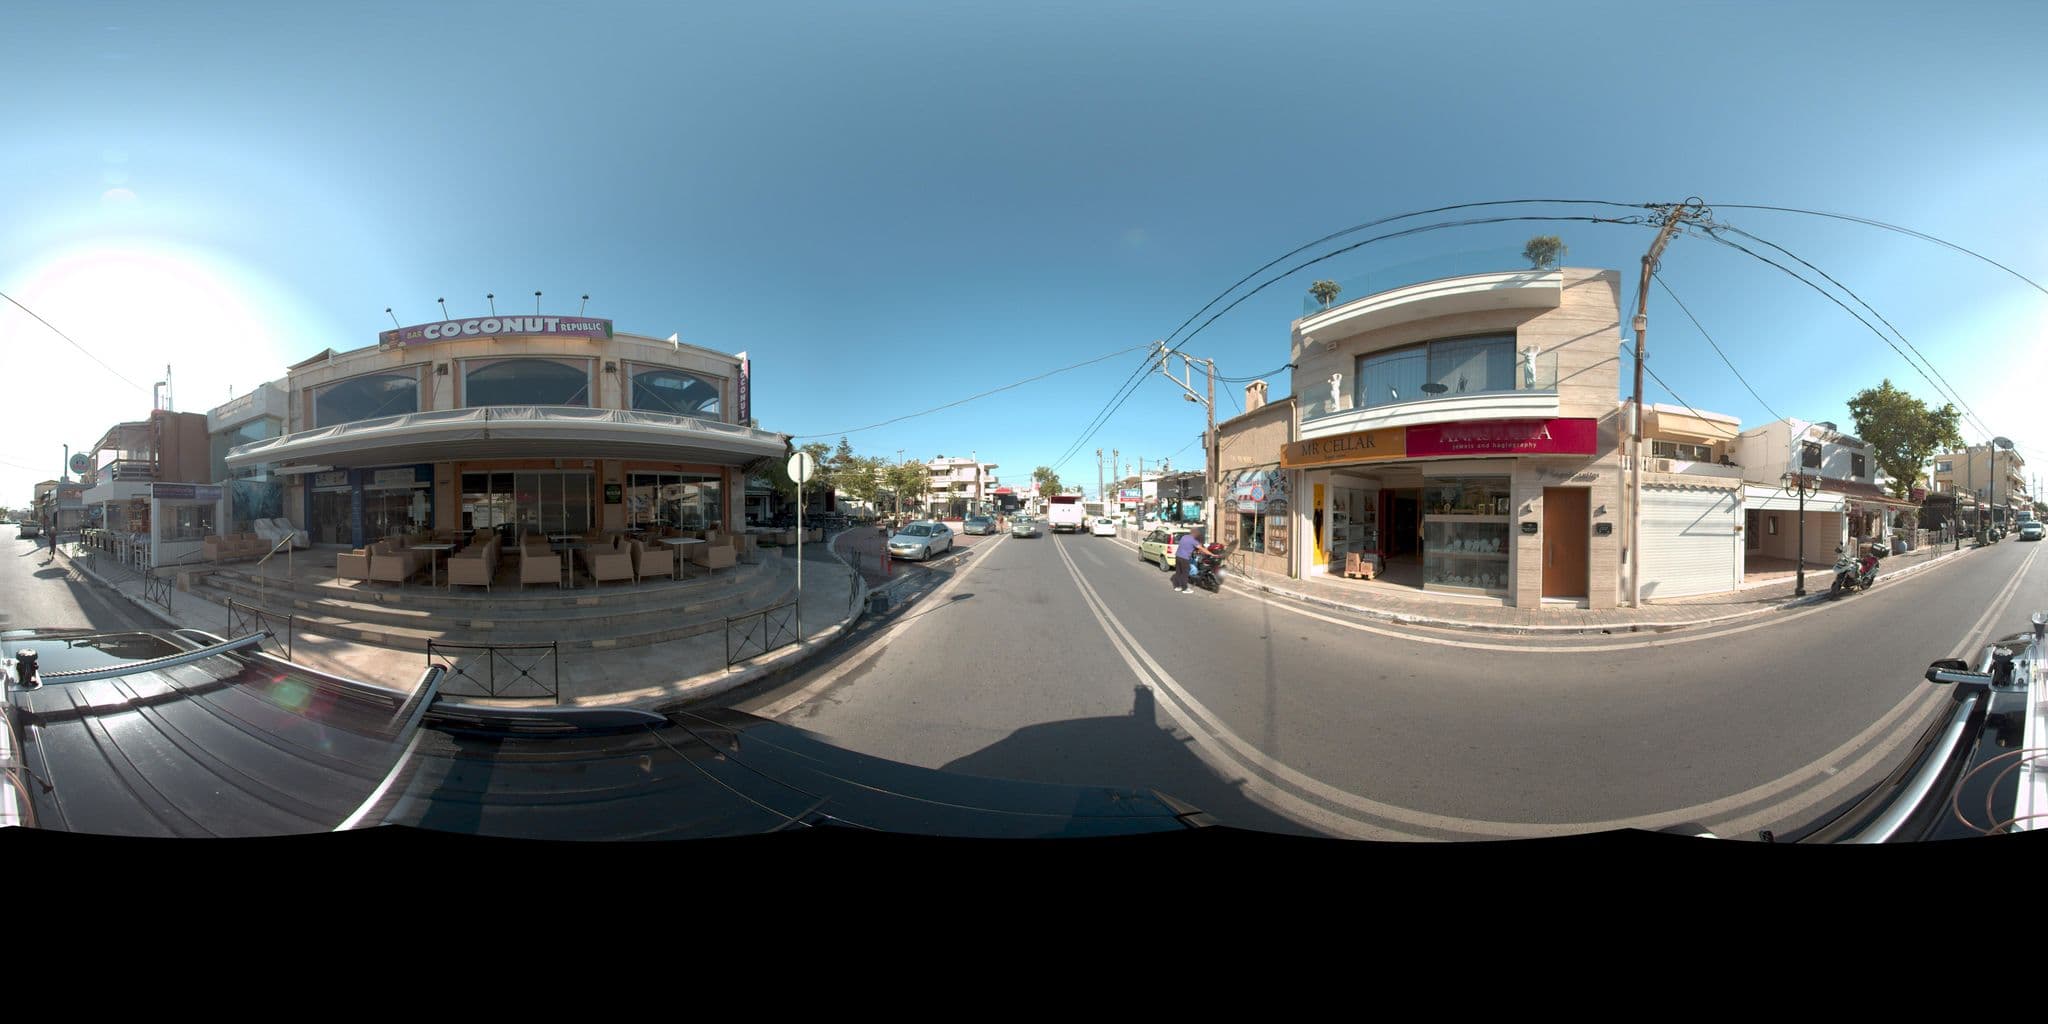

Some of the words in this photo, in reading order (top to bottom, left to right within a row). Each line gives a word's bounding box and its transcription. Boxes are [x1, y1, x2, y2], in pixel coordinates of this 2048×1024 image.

[424, 318, 560, 340] COCONUT
[560, 323, 602, 332] REPUBLIC
[1302, 441, 1320, 456] MR
[1323, 433, 1376, 453] CELLAR
